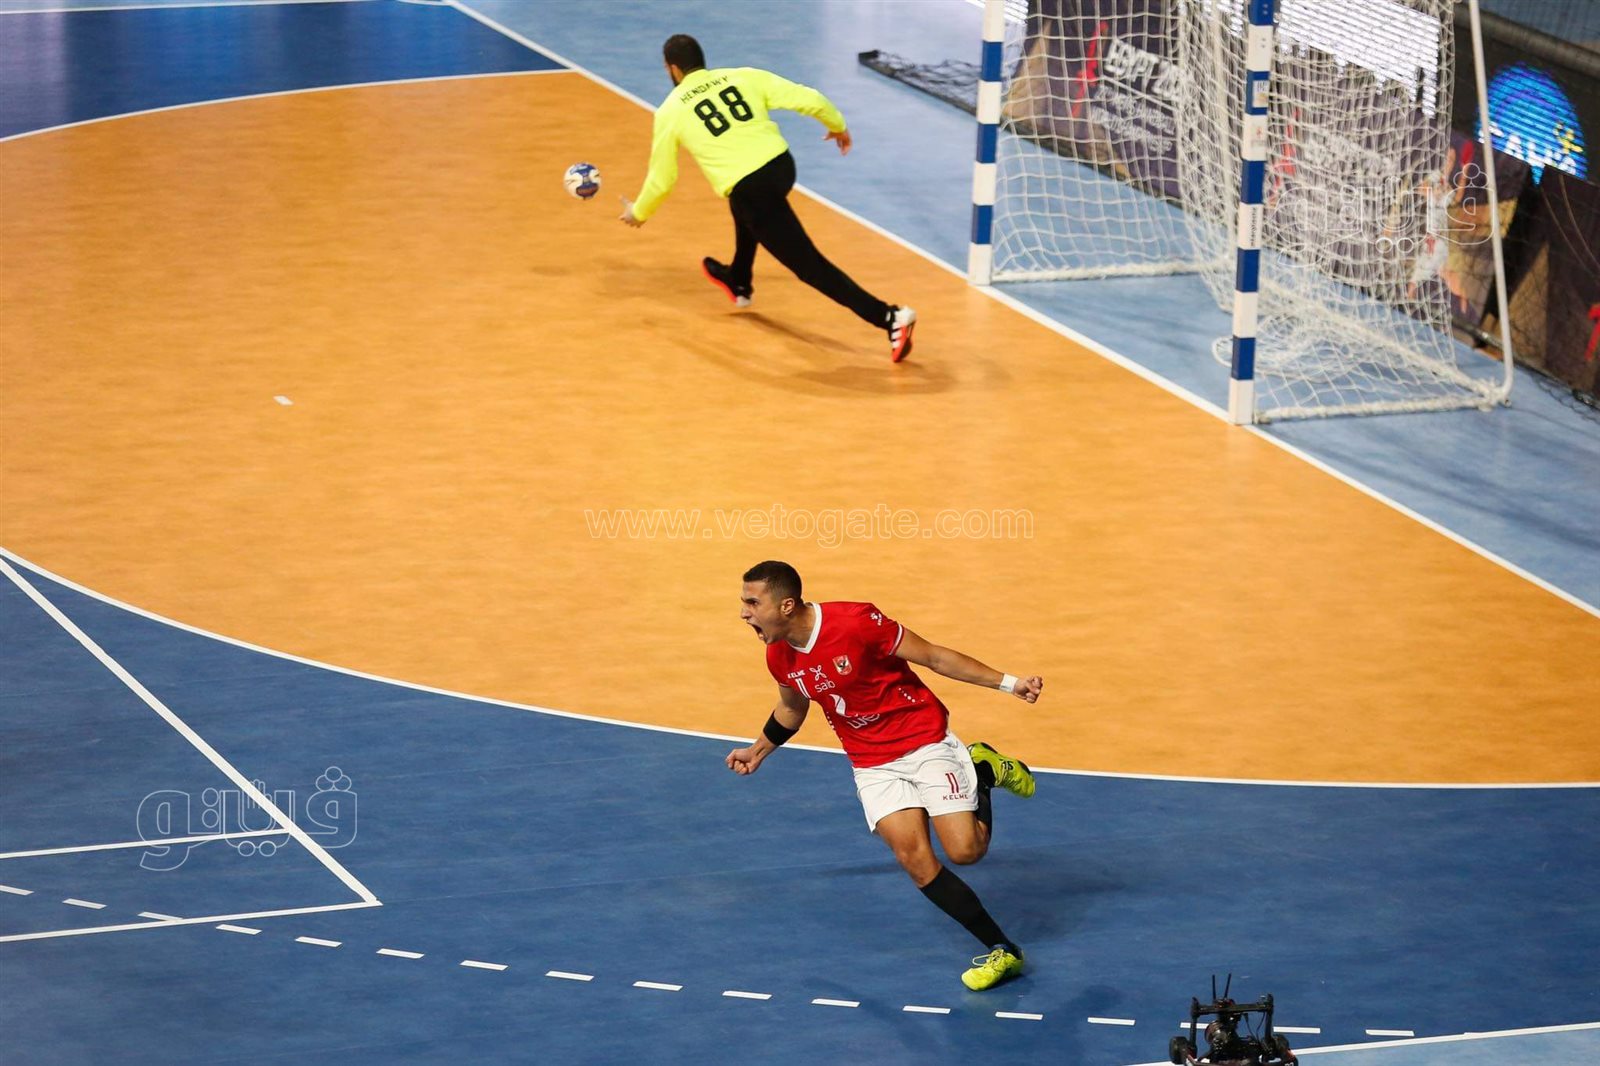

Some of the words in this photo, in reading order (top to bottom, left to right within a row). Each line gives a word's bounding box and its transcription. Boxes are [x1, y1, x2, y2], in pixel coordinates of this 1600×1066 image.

[680, 76, 728, 104] HENDAWY
[694, 85, 754, 137] 88
[945, 772, 960, 794] 11
